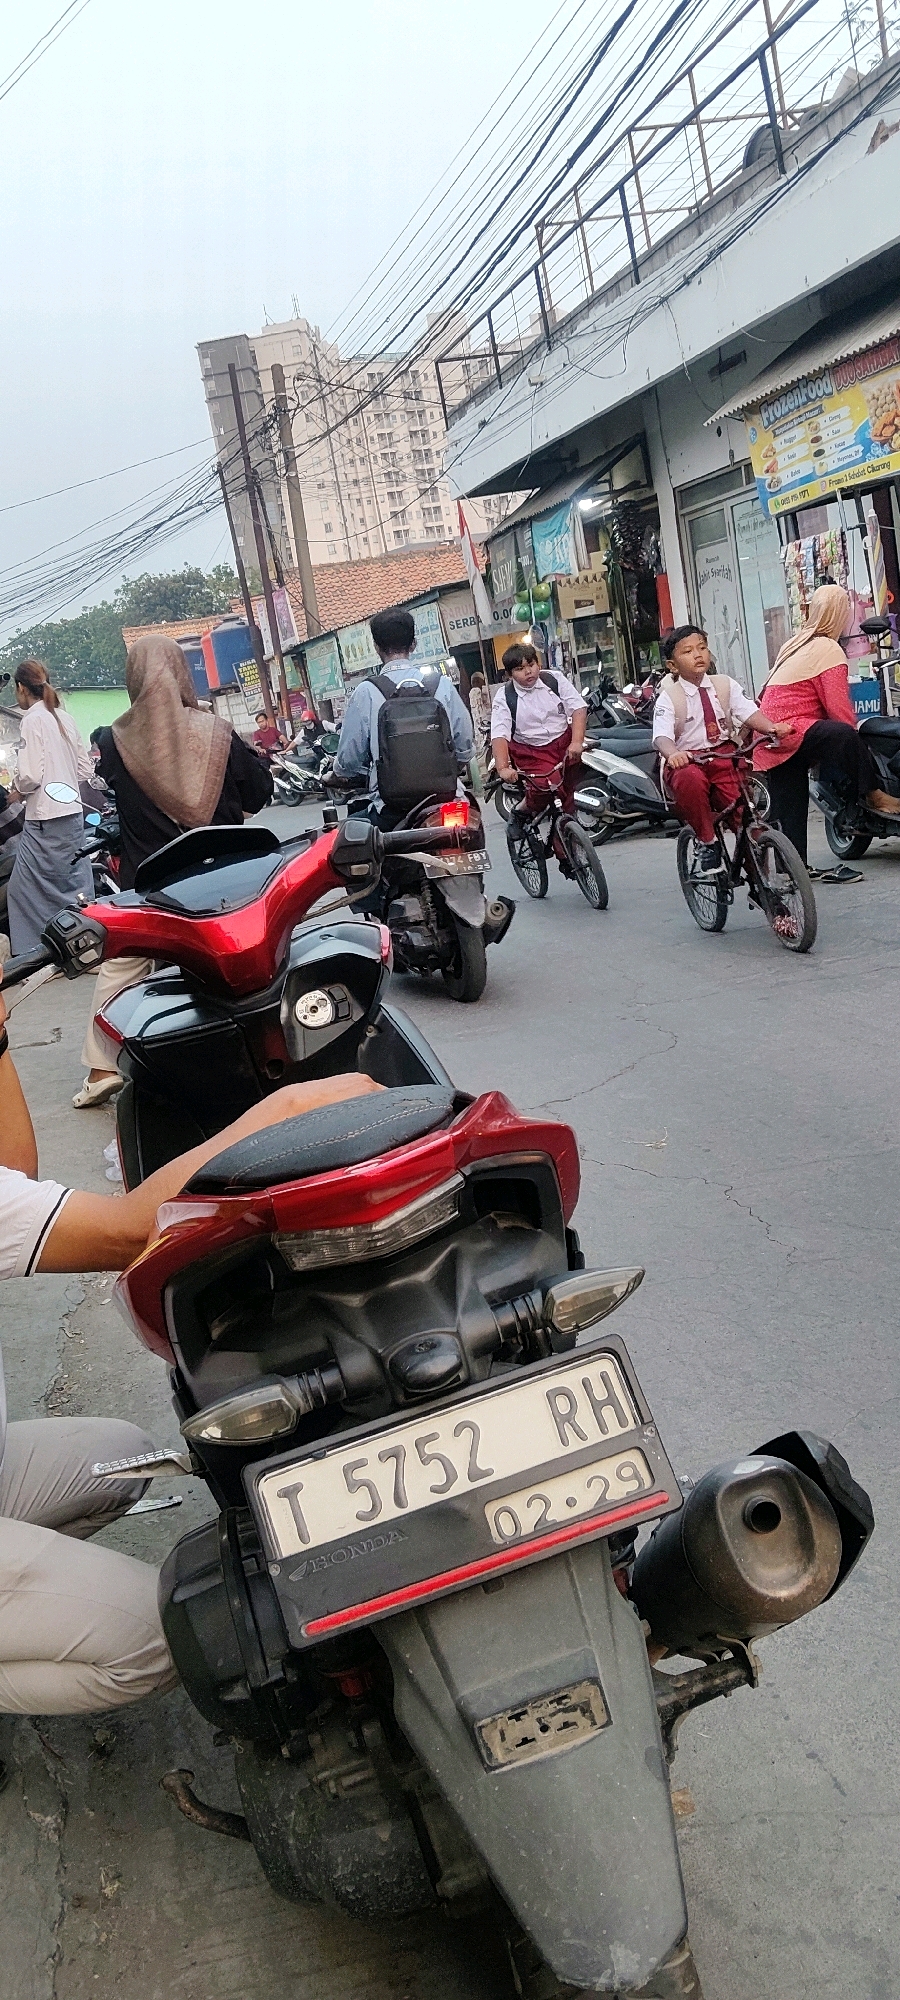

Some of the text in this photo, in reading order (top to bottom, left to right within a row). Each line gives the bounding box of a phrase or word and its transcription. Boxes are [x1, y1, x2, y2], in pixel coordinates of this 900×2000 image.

[834, 361, 856, 391] DUO
[853, 698, 881, 714] JAMU
[277, 1482, 311, 1545] T
[342, 1419, 494, 1523] 5752
[545, 1370, 630, 1447] RH
[310, 1527, 409, 1574] HONDA
